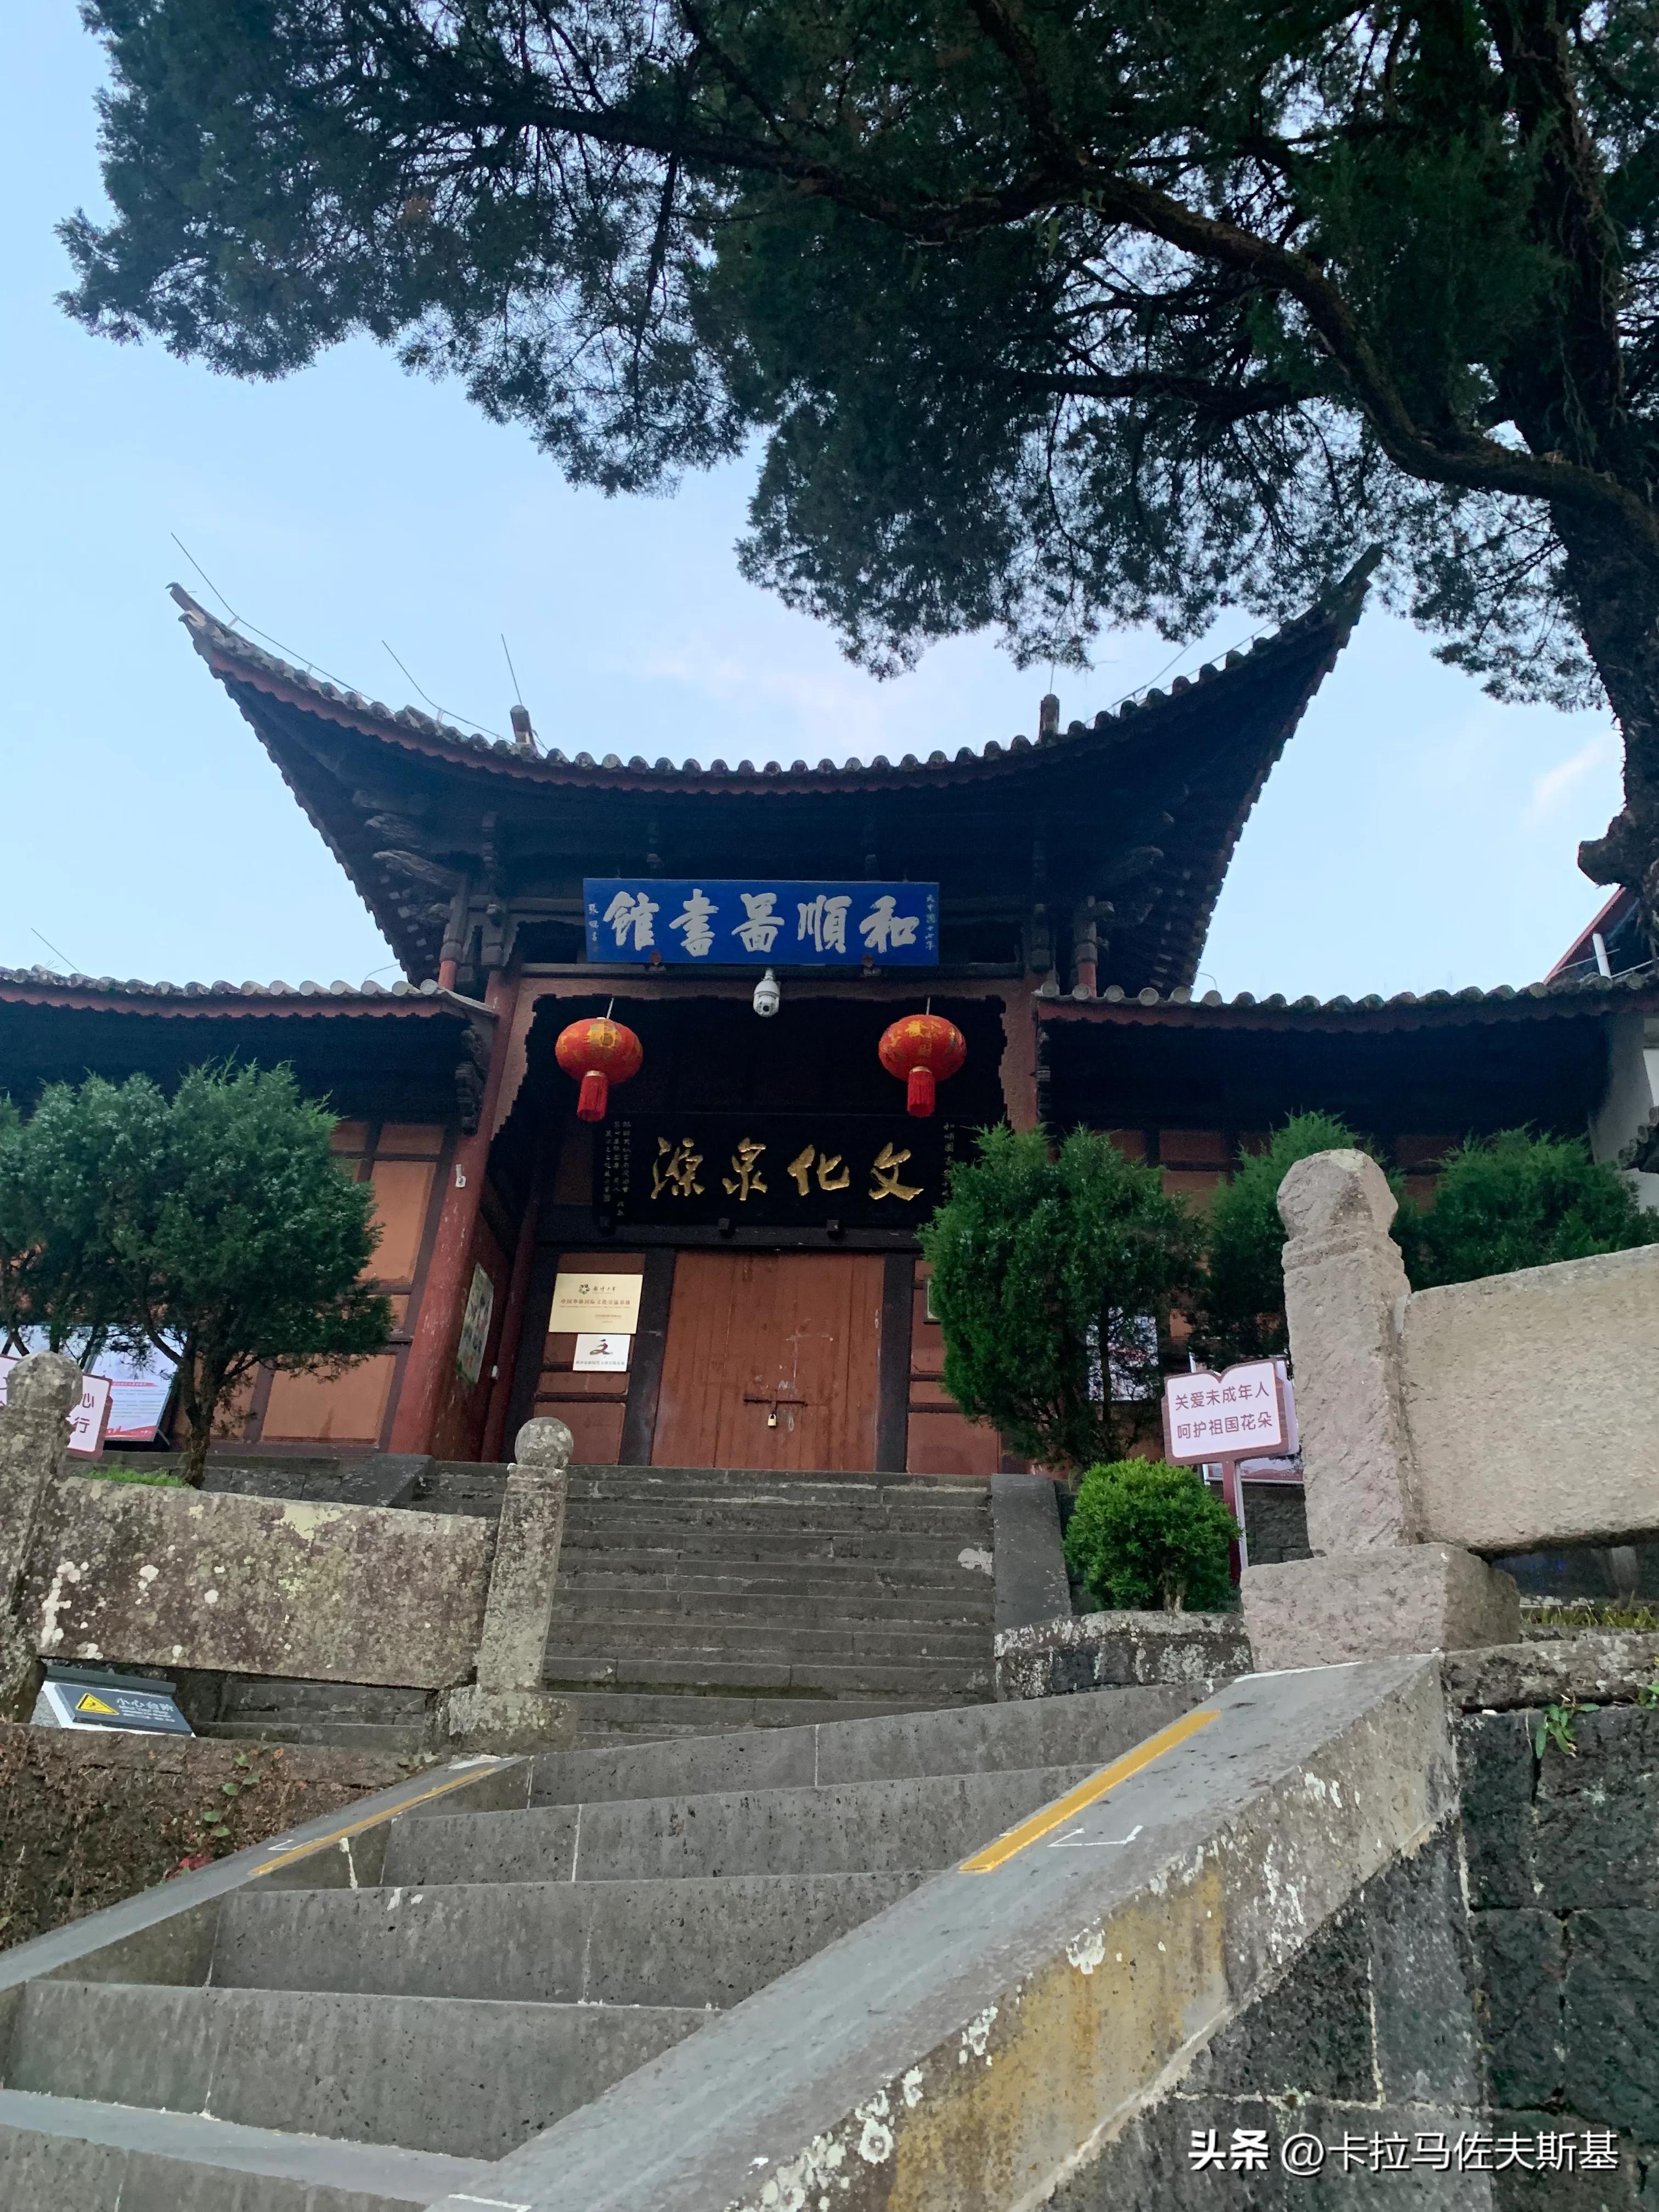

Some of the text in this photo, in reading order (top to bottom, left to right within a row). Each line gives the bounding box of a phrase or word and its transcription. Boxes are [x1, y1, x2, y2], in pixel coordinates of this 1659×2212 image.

[1175, 1381, 1269, 1411] 关爱未成年人
[1177, 1412, 1273, 1439] 呵护祖国花朵
